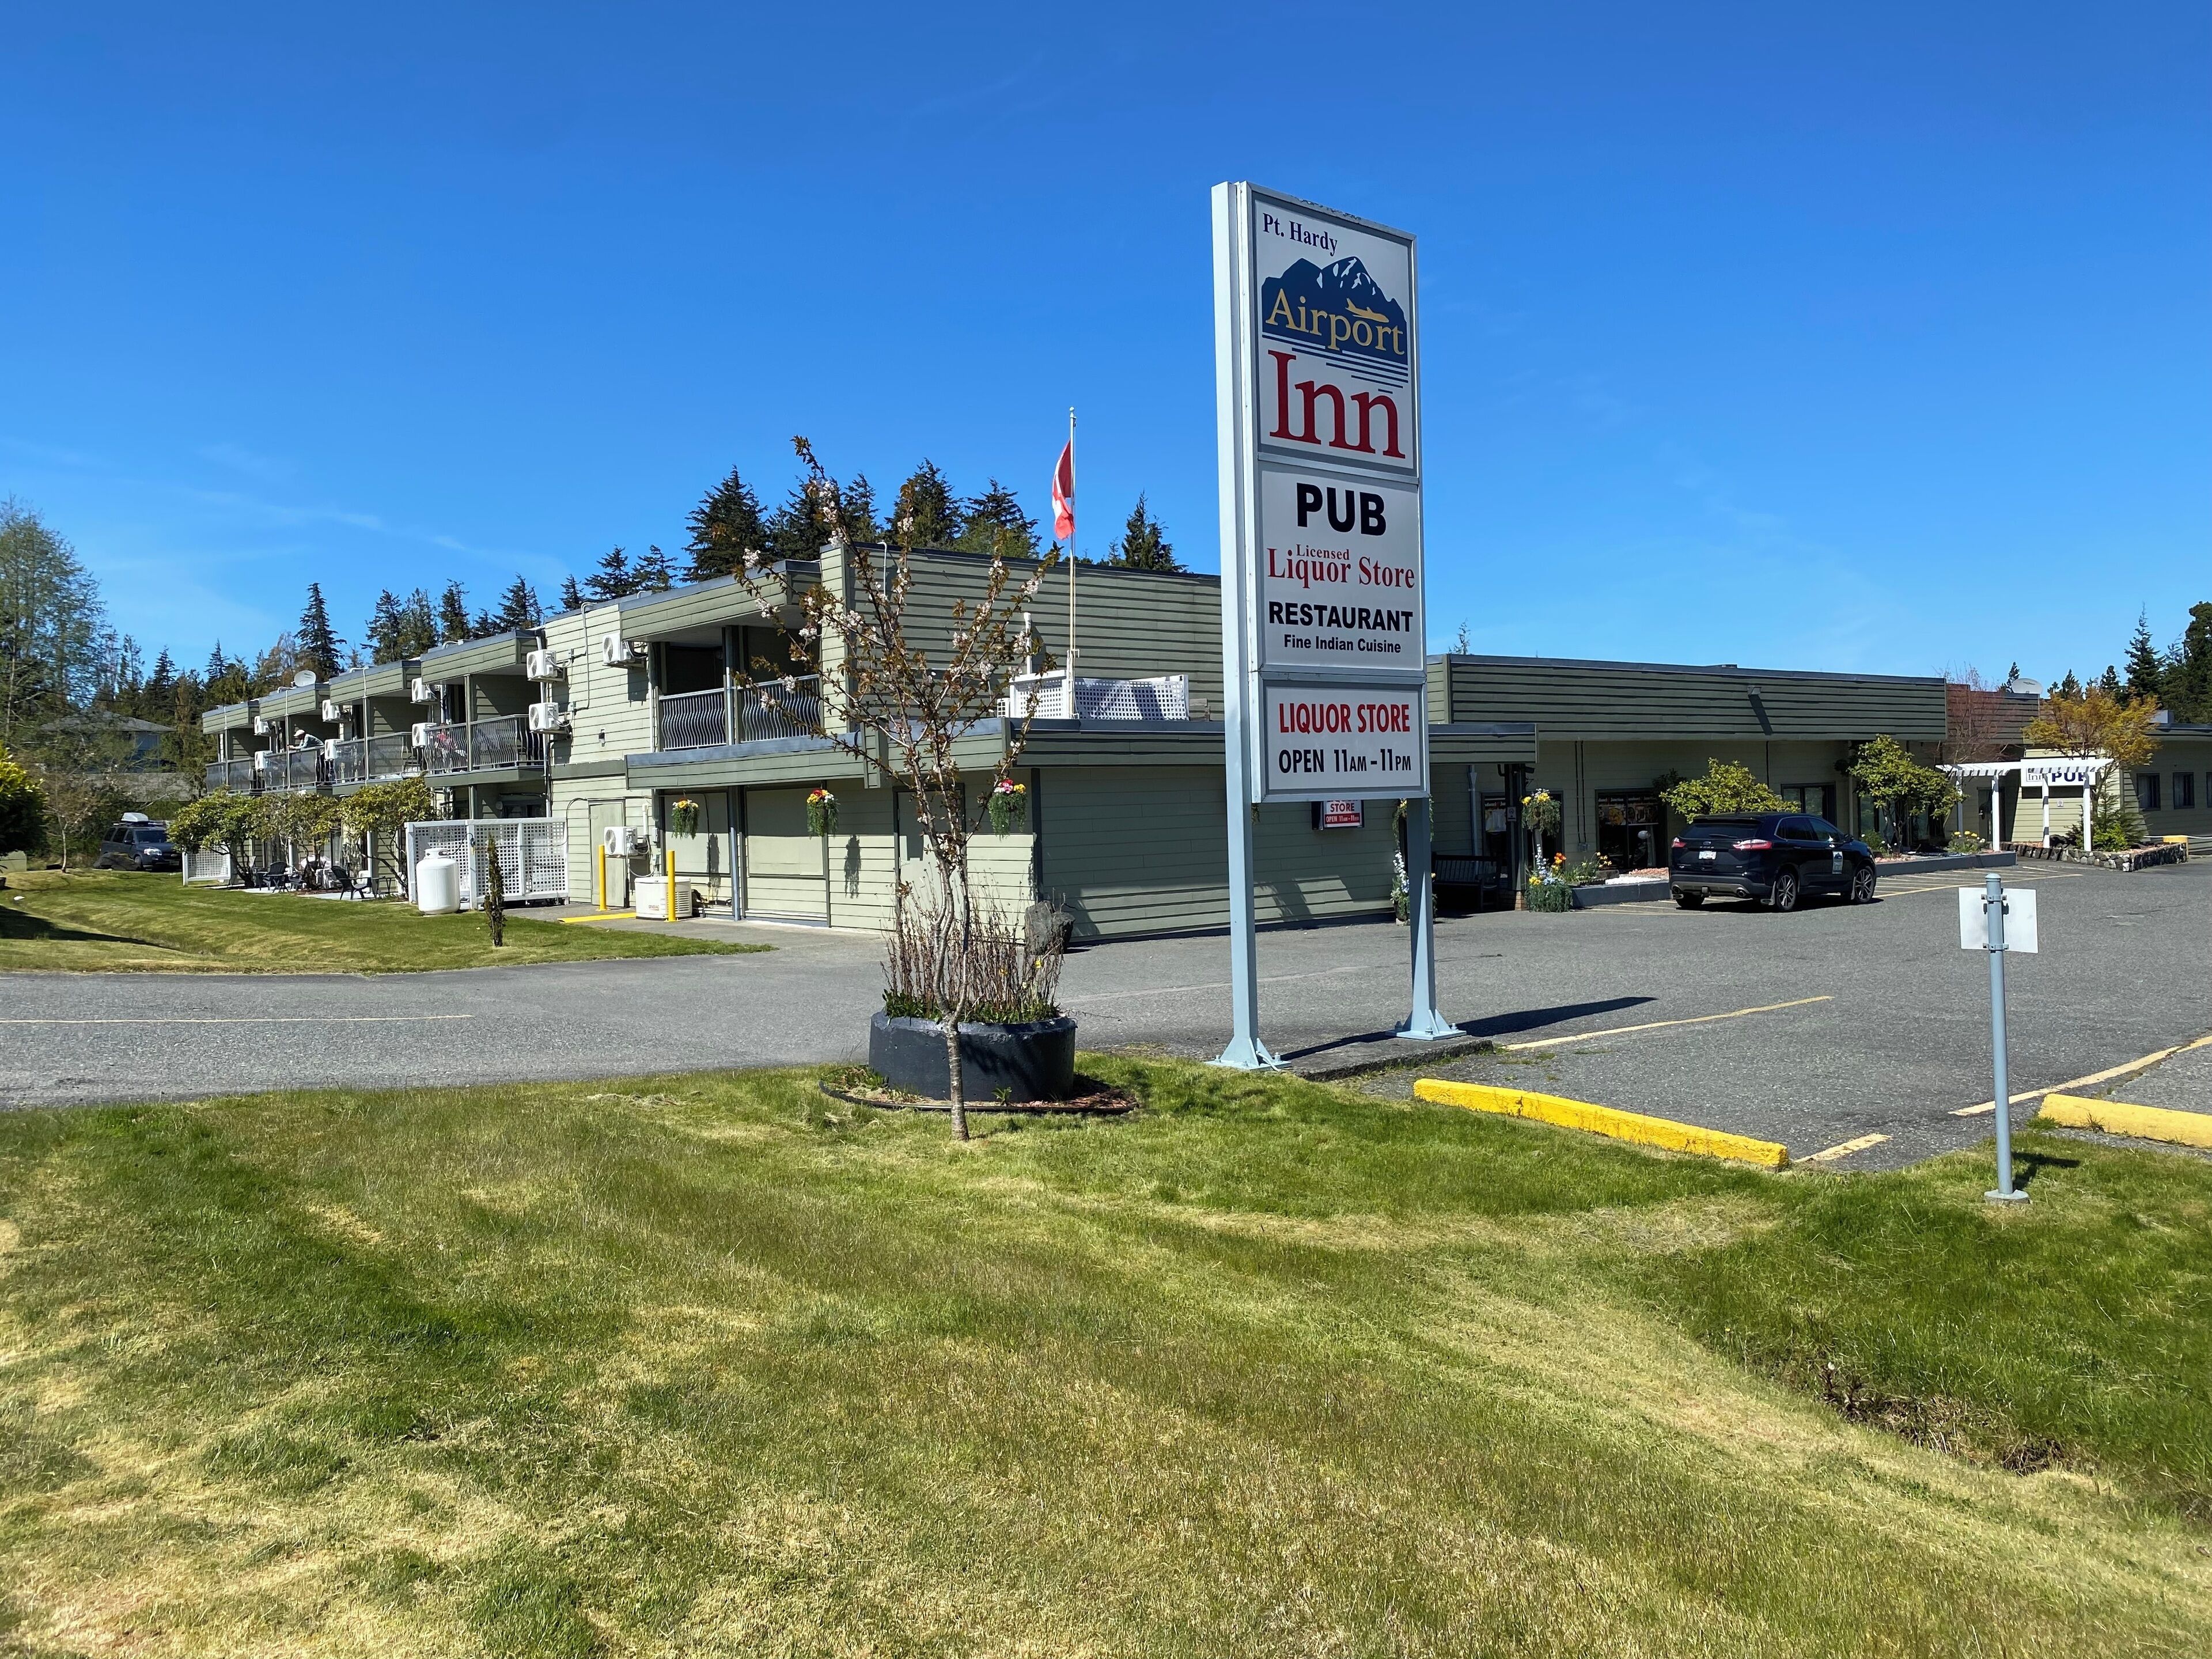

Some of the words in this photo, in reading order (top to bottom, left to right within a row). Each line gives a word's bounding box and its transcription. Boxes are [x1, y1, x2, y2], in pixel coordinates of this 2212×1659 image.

[1263, 213, 1284, 237] Pt.
[1289, 221, 1338, 256] Hardy
[1266, 289, 1404, 355] Airport
[1268, 350, 1405, 459] Inn
[1296, 482, 1387, 536] PUB
[1296, 544, 1350, 560] Licensed
[1267, 548, 1351, 589] Liquor
[1359, 556, 1415, 588] Store
[1268, 601, 1413, 632] RESTAURANT
[1284, 634, 1311, 649] Fine
[1316, 636, 1354, 651] Indian
[1358, 638, 1401, 653] Cuisine
[1279, 703, 1352, 734] LIQUOR
[1357, 704, 1410, 733] STORE
[1279, 749, 1324, 773] OPEN
[1330, 803, 1355, 812] STORE
